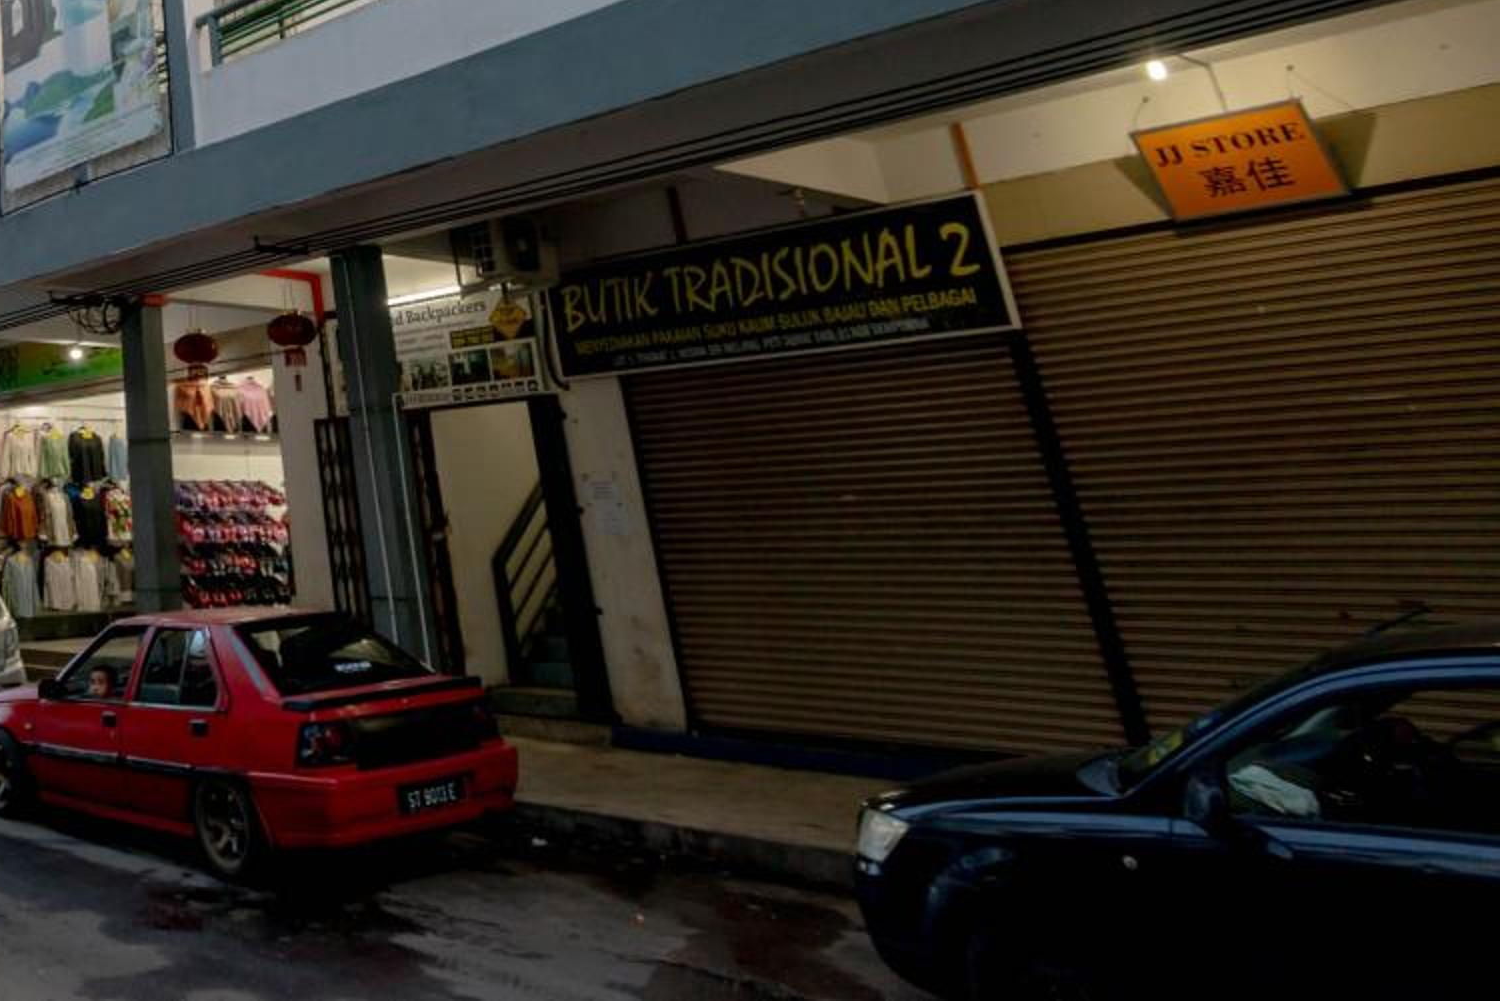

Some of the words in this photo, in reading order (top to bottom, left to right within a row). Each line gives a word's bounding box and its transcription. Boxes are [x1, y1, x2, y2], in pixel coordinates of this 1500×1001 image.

[1155, 144, 1184, 168] JJ
[1189, 122, 1304, 158] STORE
[1198, 156, 1295, 197] 嘉佳
[561, 273, 659, 332] BUTIK
[663, 224, 931, 313] TRADISIONAL
[939, 220, 981, 277] 2
[405, 300, 487, 324] Backpackers
